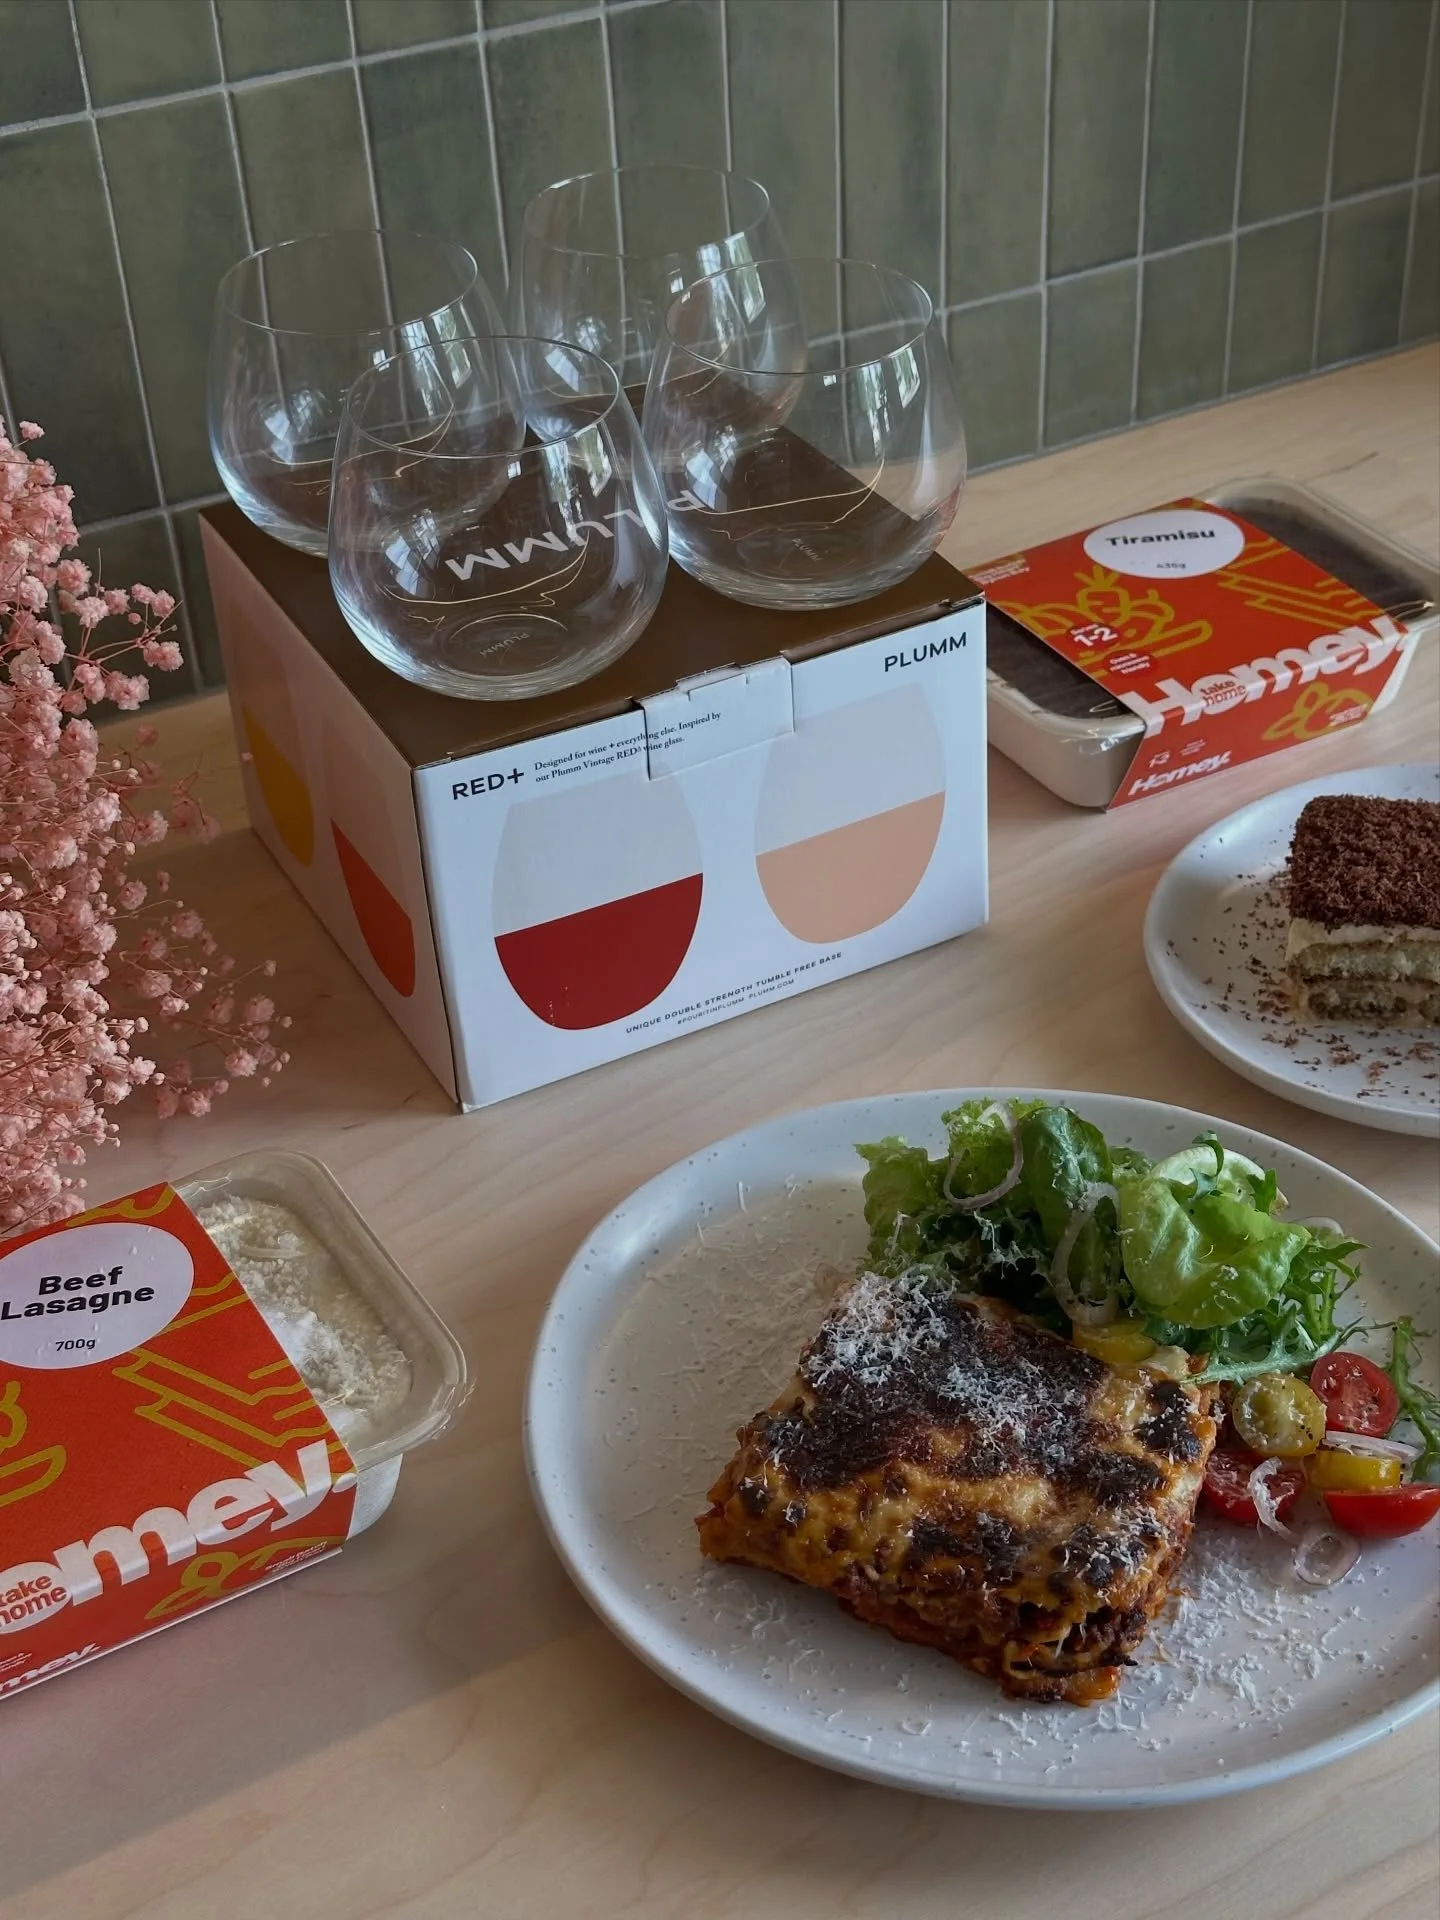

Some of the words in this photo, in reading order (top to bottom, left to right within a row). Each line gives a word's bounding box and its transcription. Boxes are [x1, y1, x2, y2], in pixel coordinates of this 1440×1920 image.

[1105, 530, 1216, 547] Tiramisu
[884, 631, 967, 673] PLUMM
[1073, 626, 1119, 648] 1-2
[1200, 680, 1236, 696] take
[1202, 685, 1246, 707] home
[534, 752, 573, 771] Designed
[574, 750, 587, 760] for
[588, 745, 607, 756] wine
[616, 731, 659, 748] everythng
[660, 725, 677, 736] else.
[679, 713, 711, 731] Inspired
[711, 711, 721, 722] by
[535, 774, 551, 783] our
[551, 764, 582, 779] Plumm
[583, 754, 615, 770] Vintage
[643, 743, 662, 752] wine
[452, 767, 525, 801] RED+
[626, 1016, 662, 1034] UNIQUE
[664, 1002, 702, 1020] DOUBLE
[704, 984, 753, 1006] STRENGTH
[756, 970, 792, 988] TUMBLE
[794, 960, 817, 974] FREE
[819, 951, 842, 965] BASE
[38, 1265, 124, 1296] Beef
[0, 1286, 155, 1321] Lasagne
[55, 1338, 96, 1352] 700g
